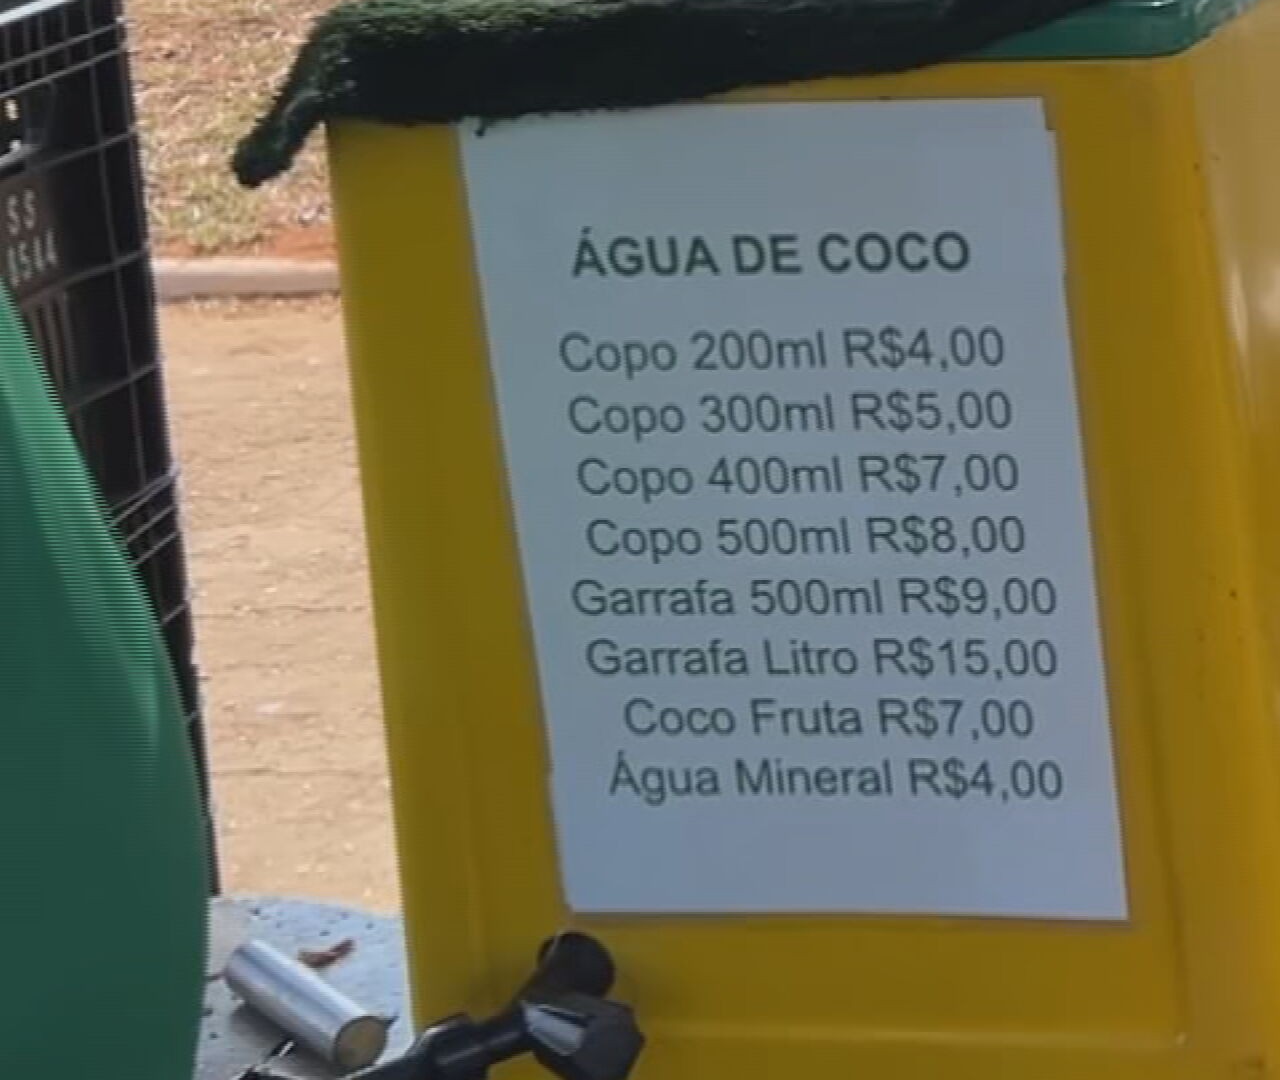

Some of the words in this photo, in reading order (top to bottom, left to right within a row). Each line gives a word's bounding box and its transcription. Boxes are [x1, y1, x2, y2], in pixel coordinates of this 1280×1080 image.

[572, 225, 720, 278] ÁGUA
[731, 234, 803, 276] DE
[817, 230, 970, 274] COCO
[559, 332, 677, 379] Copo
[690, 330, 827, 370] 200ml
[842, 326, 1004, 372] R$4,00
[568, 396, 685, 443] Copo
[699, 393, 835, 434] 300ml
[850, 388, 1012, 435] R$5,00
[577, 458, 694, 504] Copo
[707, 456, 843, 494] 400ml
[858, 452, 1018, 498] R$7,00
[586, 518, 702, 564] Copo
[717, 516, 851, 556] 500ml
[865, 514, 1025, 559] R$8,00
[571, 579, 736, 616] Garrafa
[750, 578, 883, 616] 500ml
[897, 576, 1057, 620] R$9,00
[586, 638, 749, 676] Garrafa
[763, 640, 858, 676] Litro
[873, 636, 1057, 680] R$15,00
[624, 698, 736, 736] Coco
[750, 698, 864, 736] Fruta
[877, 696, 1034, 741] R$7,00
[610, 751, 721, 806] Água
[735, 758, 893, 796] Mineral
[908, 756, 1063, 801] R$4,00
